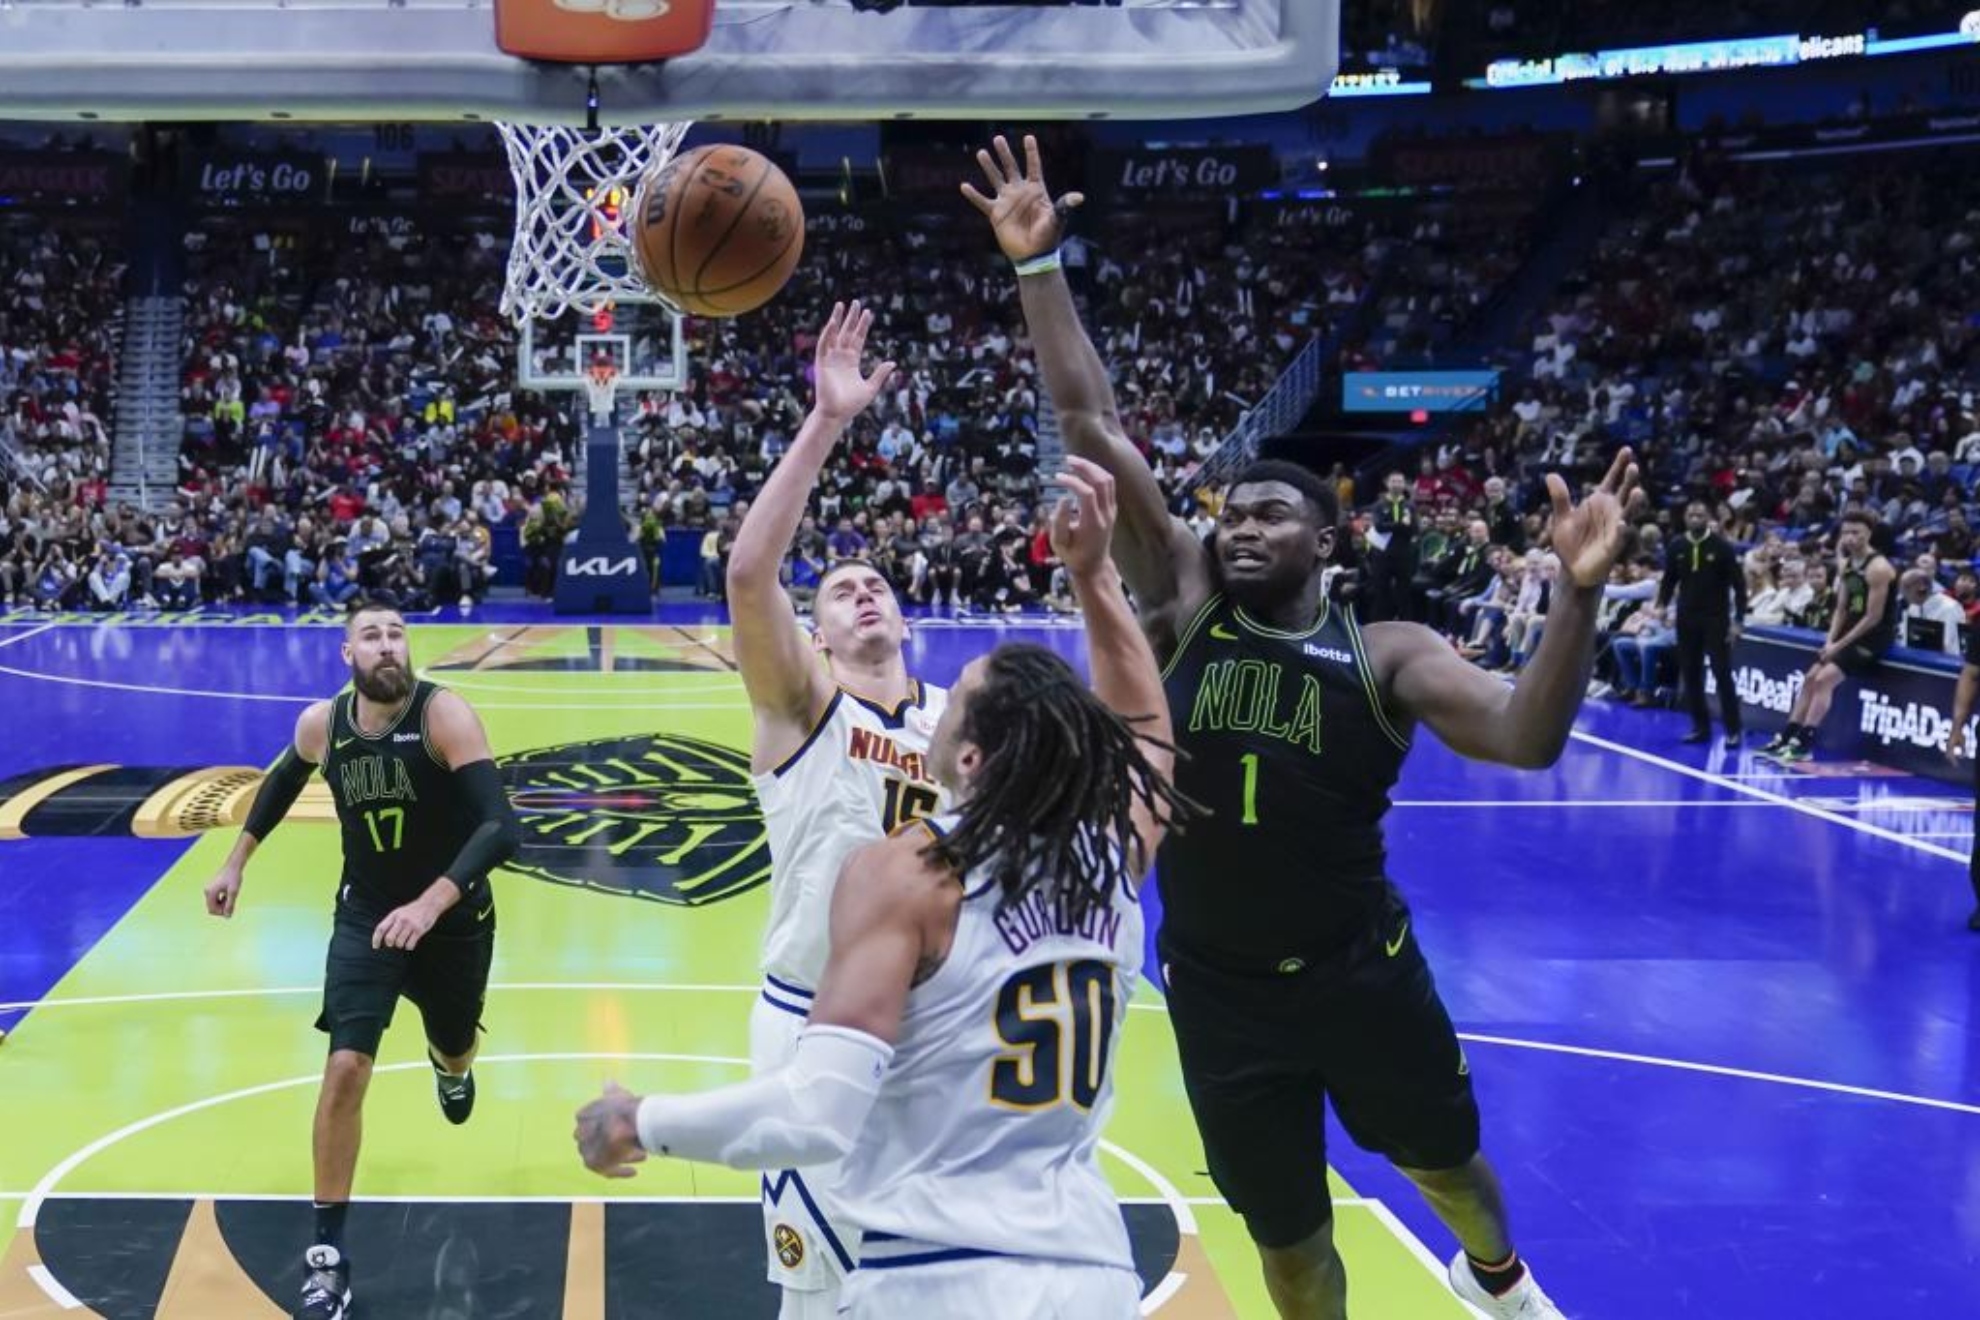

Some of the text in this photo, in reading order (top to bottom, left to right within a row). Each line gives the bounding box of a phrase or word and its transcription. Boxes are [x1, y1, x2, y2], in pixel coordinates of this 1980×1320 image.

[201, 163, 310, 191] Let's Go
[1122, 157, 1237, 187] Let's Go
[566, 557, 637, 575] KIA
[1189, 659, 1322, 754] NOLA
[340, 755, 418, 806] NOLA
[1240, 754, 1259, 825] 1
[364, 806, 404, 852] 17
[989, 957, 1116, 1113] 50
